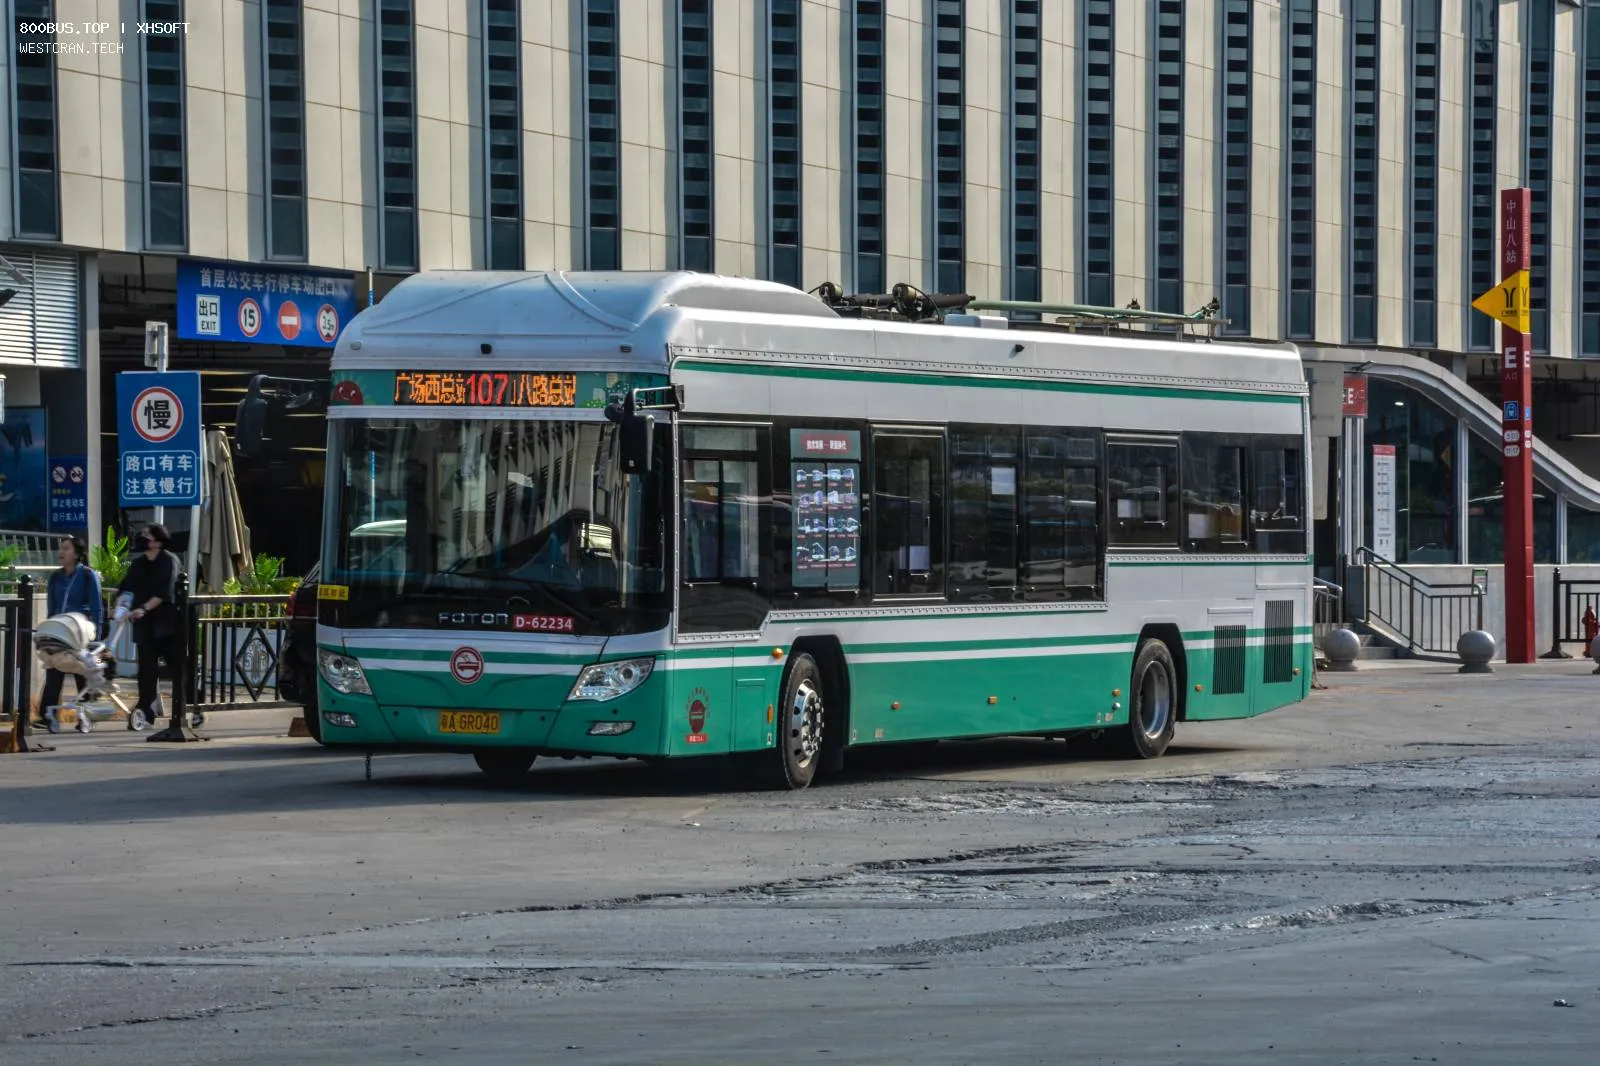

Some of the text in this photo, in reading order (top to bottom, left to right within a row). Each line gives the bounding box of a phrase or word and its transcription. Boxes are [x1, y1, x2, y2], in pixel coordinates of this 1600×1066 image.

[1506, 199, 1517, 264] 中山八站
[199, 300, 218, 317] 出口
[201, 320, 217, 331] EXIT
[243, 309, 256, 328] 15
[1504, 346, 1517, 369] E
[1524, 350, 1530, 369] E
[466, 374, 508, 405] 107
[144, 399, 172, 430] 慢
[125, 455, 193, 471] 路口有车
[125, 477, 194, 495] 注意慢行
[515, 616, 573, 630] D-62234
